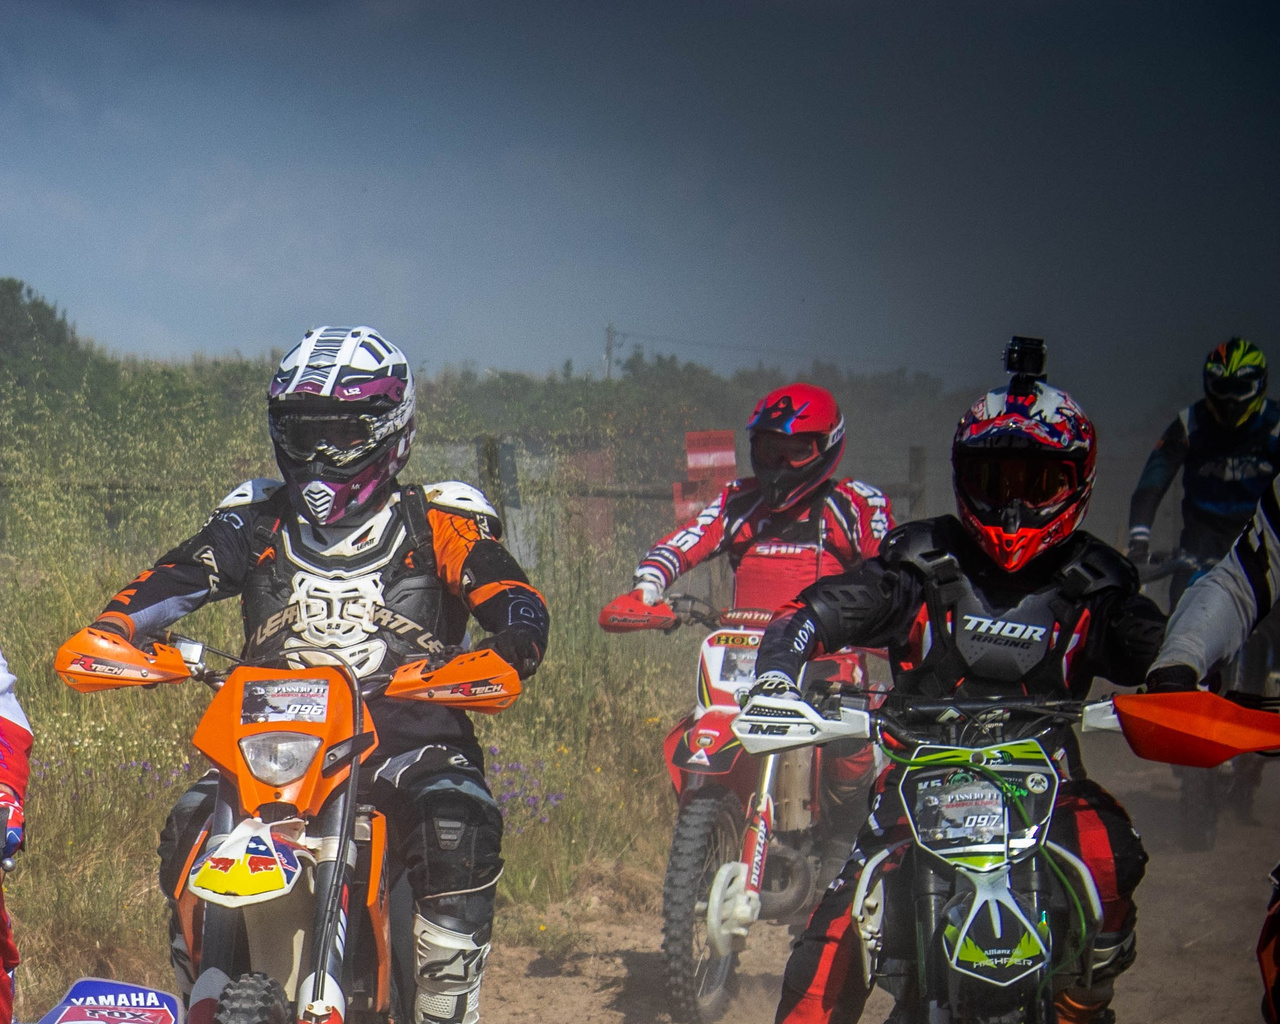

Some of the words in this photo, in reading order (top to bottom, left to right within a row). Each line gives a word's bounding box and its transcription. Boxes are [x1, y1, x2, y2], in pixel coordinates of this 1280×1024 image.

[343, 388, 361, 396] LS2
[357, 537, 376, 551] LEATT
[964, 615, 1047, 642] THOR
[971, 633, 1032, 650] RACING
[287, 704, 324, 715] 096
[748, 723, 791, 735] IMS
[964, 815, 1000, 827] 097
[750, 818, 767, 887] DUNLOP
[984, 948, 1011, 956] Allianz
[71, 992, 160, 1007] YAMAHA
[85, 1008, 154, 1024] FOX
